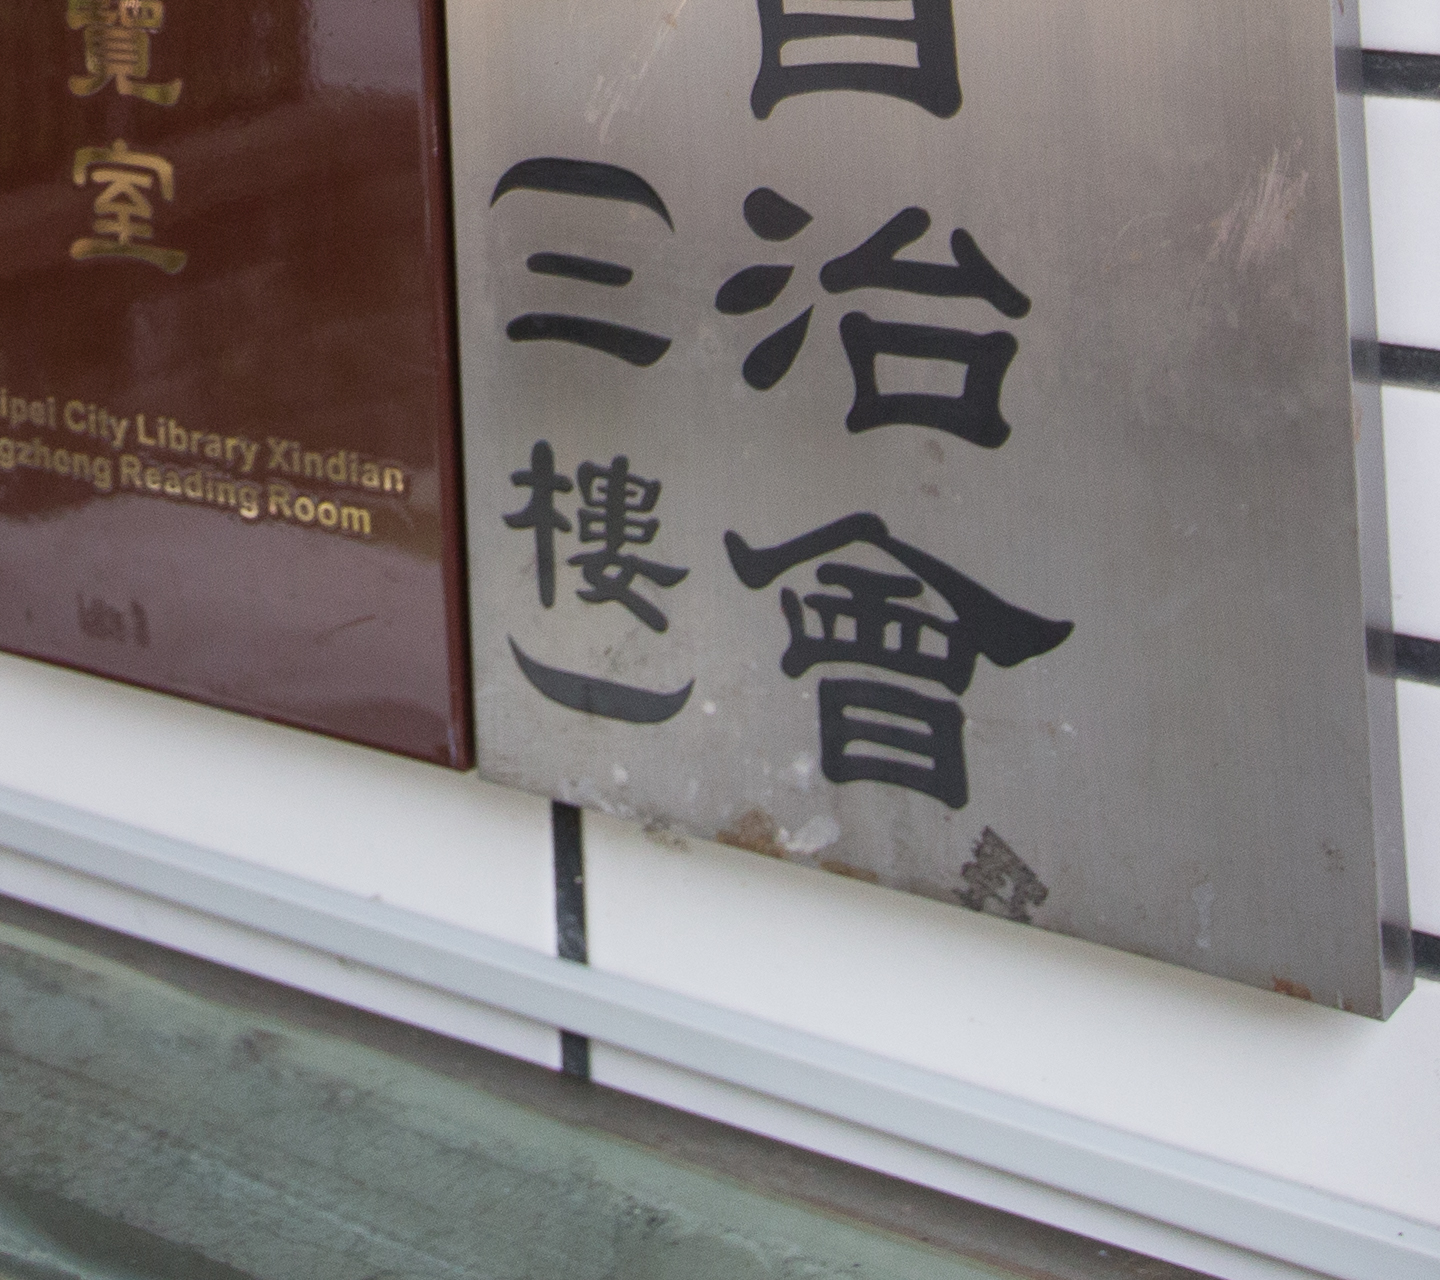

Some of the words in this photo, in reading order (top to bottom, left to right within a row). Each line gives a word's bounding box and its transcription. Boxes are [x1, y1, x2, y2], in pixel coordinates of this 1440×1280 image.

[63, 398, 130, 449] City
[136, 413, 259, 473] Library
[266, 440, 406, 493] Xindian
[121, 455, 260, 519] Reading
[267, 482, 372, 536] Room
